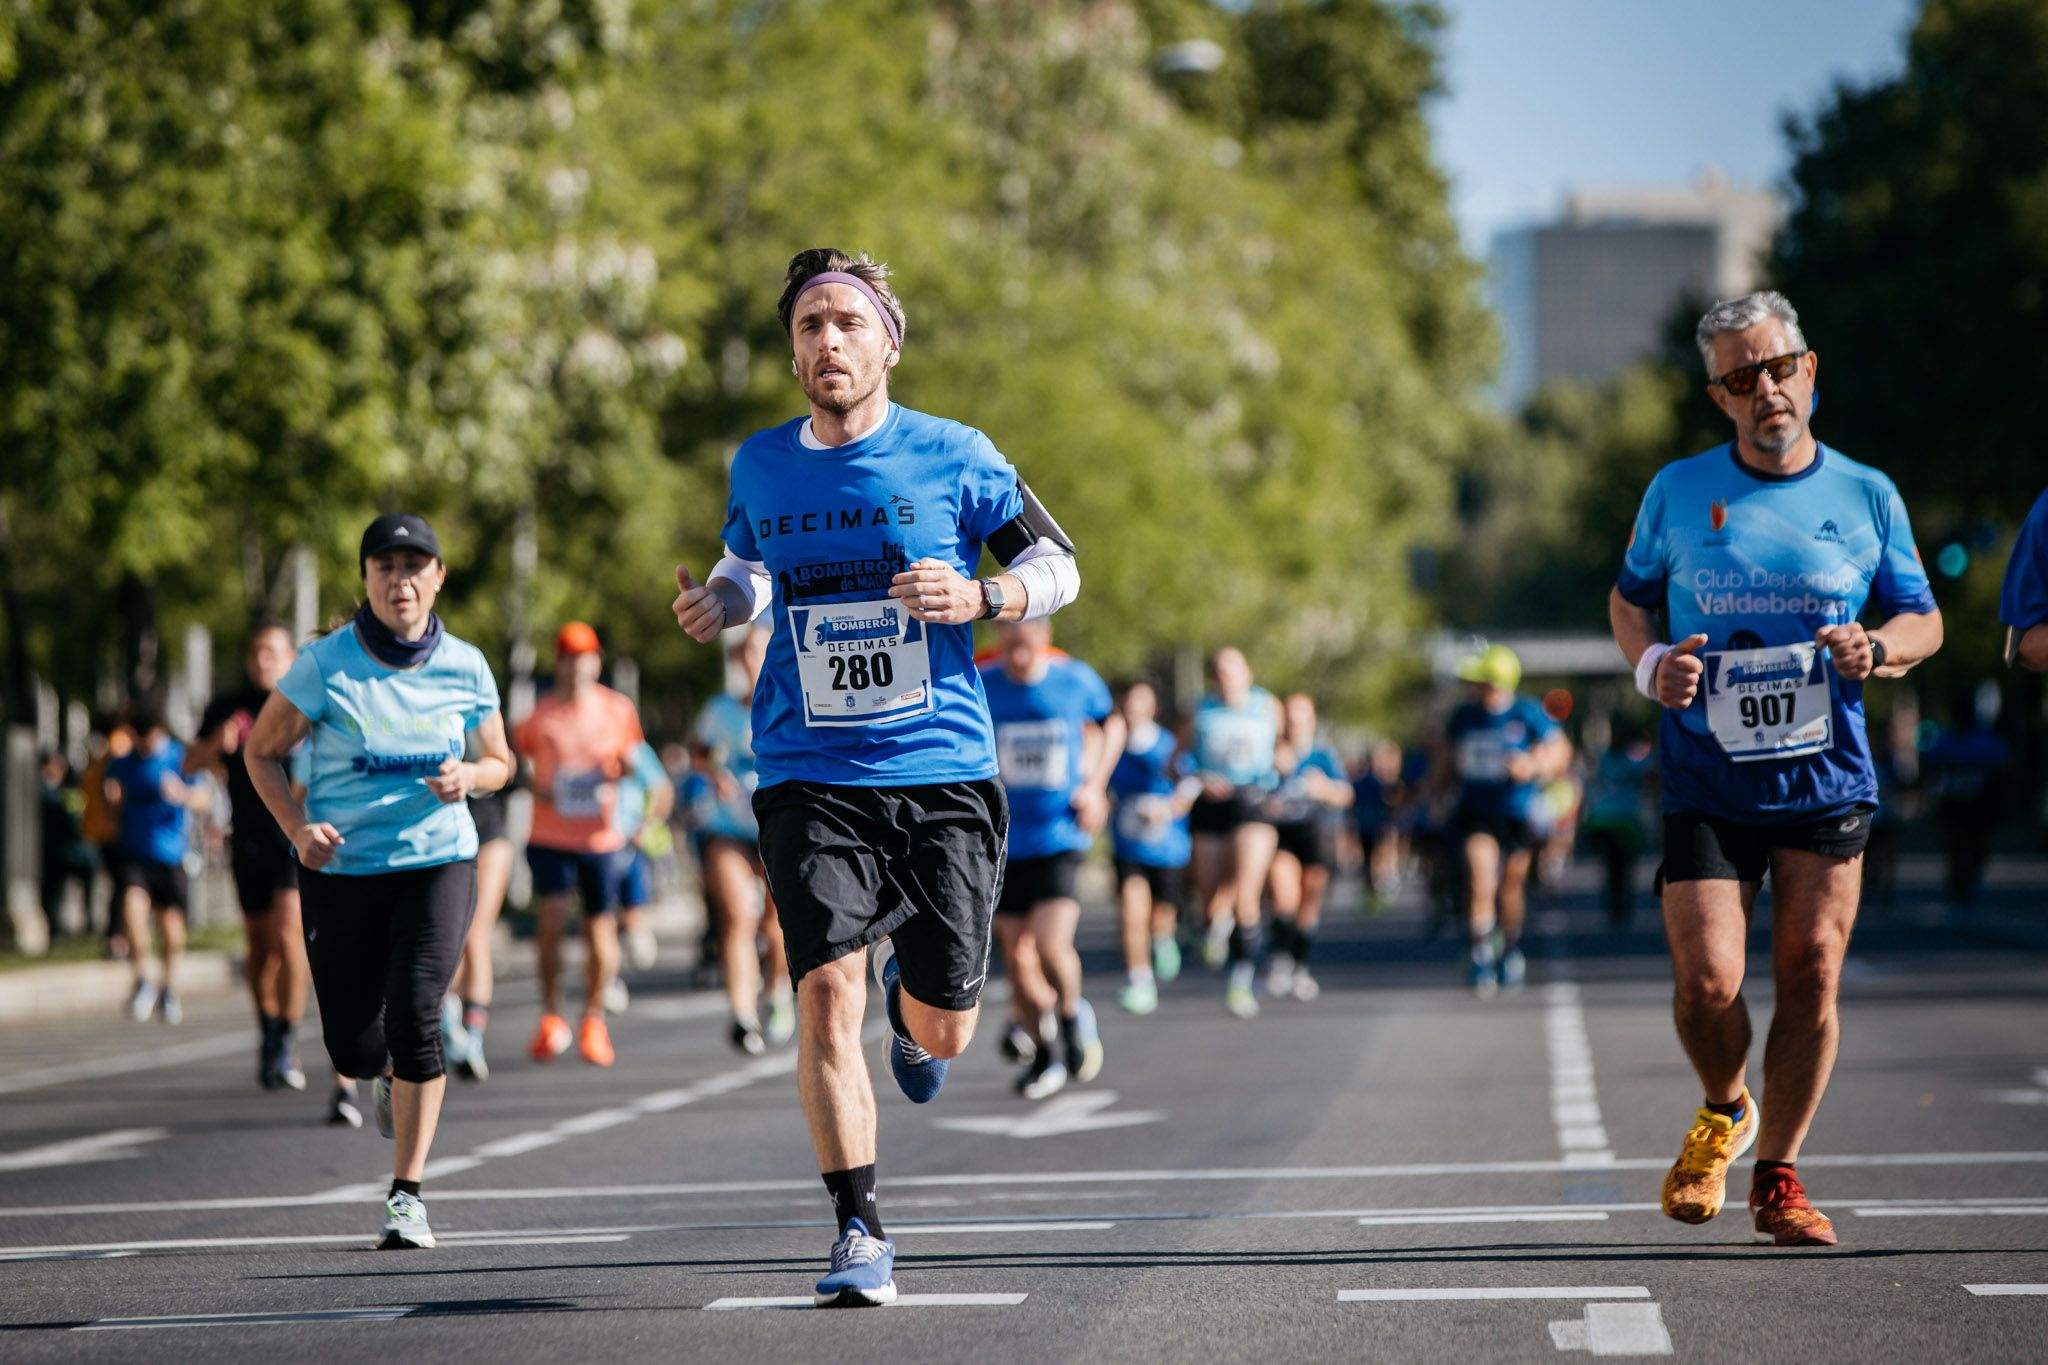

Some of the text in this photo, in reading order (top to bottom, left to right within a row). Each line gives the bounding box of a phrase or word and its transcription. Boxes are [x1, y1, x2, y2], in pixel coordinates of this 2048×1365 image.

[760, 504, 916, 539] DECIMAS
[800, 560, 901, 581] BOMBEROS
[1695, 567, 1853, 593] Club Deportivo
[840, 576, 855, 591] de
[832, 617, 896, 632] BOMBEROS
[828, 637, 897, 653] DECIMAS
[828, 651, 893, 692] 280
[1738, 678, 1802, 695] DECIMAS
[1739, 692, 1797, 728] 907
